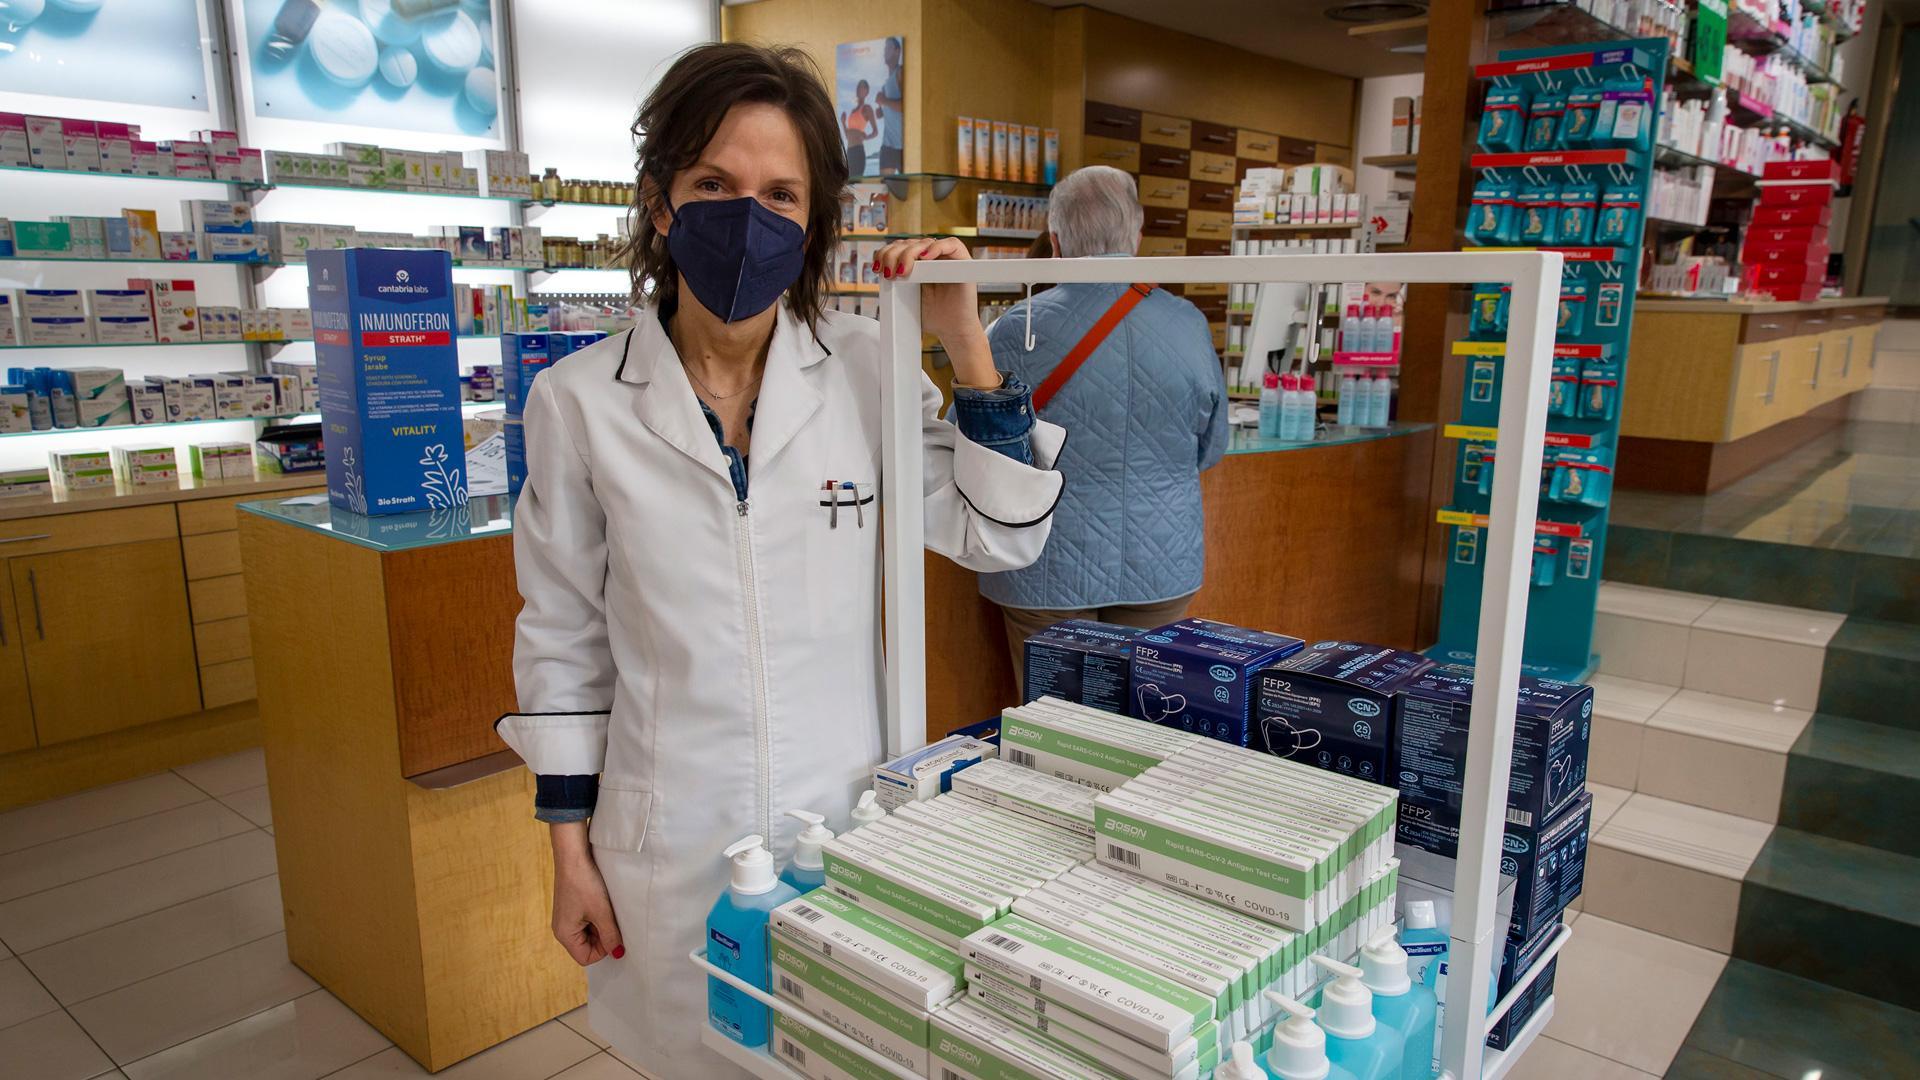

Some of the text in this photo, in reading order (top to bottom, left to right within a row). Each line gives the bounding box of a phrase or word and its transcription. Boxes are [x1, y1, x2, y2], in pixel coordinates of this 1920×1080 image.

[1516, 62, 1550, 72] AMPOLLAS
[1530, 156, 1563, 164] AMPOLLAS
[1564, 251, 1591, 259] MPOLLAS
[378, 285, 428, 293] cantabria labs
[360, 312, 450, 331] INMUNOFERON
[364, 354, 386, 362] Syrup
[364, 363, 388, 372] Jarabe
[392, 425, 437, 436] VITALITY
[1136, 646, 1159, 659] FFP2
[1263, 677, 1291, 692] FFP2
[1216, 690, 1226, 698] 25
[1262, 698, 1271, 706] CE
[1008, 725, 1043, 741] BOSON
[1356, 724, 1368, 734] 25
[1401, 803, 1432, 820] FFP2
[1104, 818, 1147, 838] BOSON
[1399, 824, 1409, 833] CE
[1165, 839, 1289, 884] Rapid SARS-CoV-2 Antigen Test Card
[1502, 861, 1514, 870] 25
[830, 862, 862, 882] BOSON
[1225, 894, 1236, 903] CE
[1244, 900, 1290, 921] COVID-19
[777, 949, 808, 974] BOSON
[876, 954, 888, 962] CE
[891, 961, 928, 983] COVID-19
[1098, 988, 1112, 998] CE
[1116, 996, 1165, 1021] COVID-19
[779, 1014, 810, 1038] BOSON
[880, 1044, 914, 1069] COVID-19
[939, 1039, 982, 1065] BOSON
